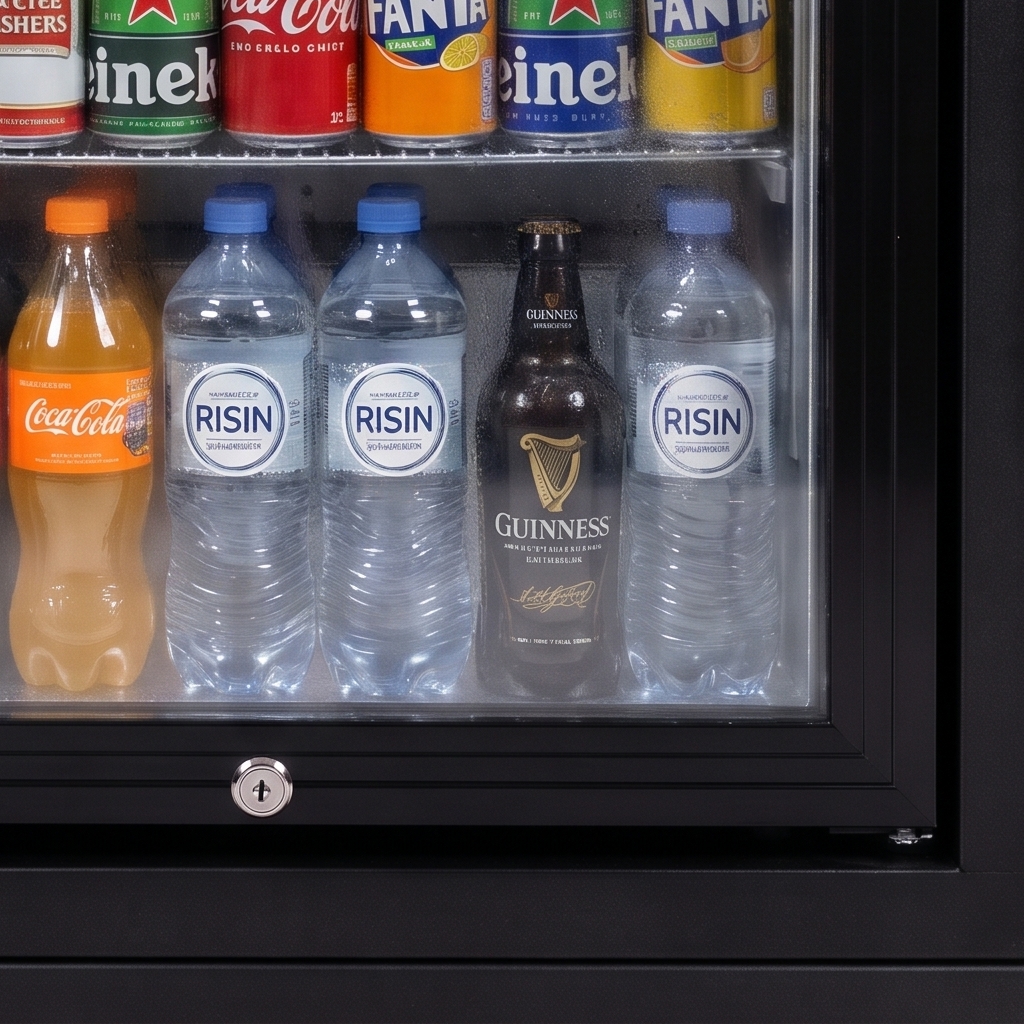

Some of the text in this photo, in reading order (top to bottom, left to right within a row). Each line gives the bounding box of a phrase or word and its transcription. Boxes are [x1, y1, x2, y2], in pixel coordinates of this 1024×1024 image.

[25, 397, 128, 436] Coca-Cola
[196, 405, 272, 433] RISIN
[356, 405, 432, 433] RISIN
[664, 407, 741, 435] RISIN
[495, 512, 610, 539] GUINNESS
